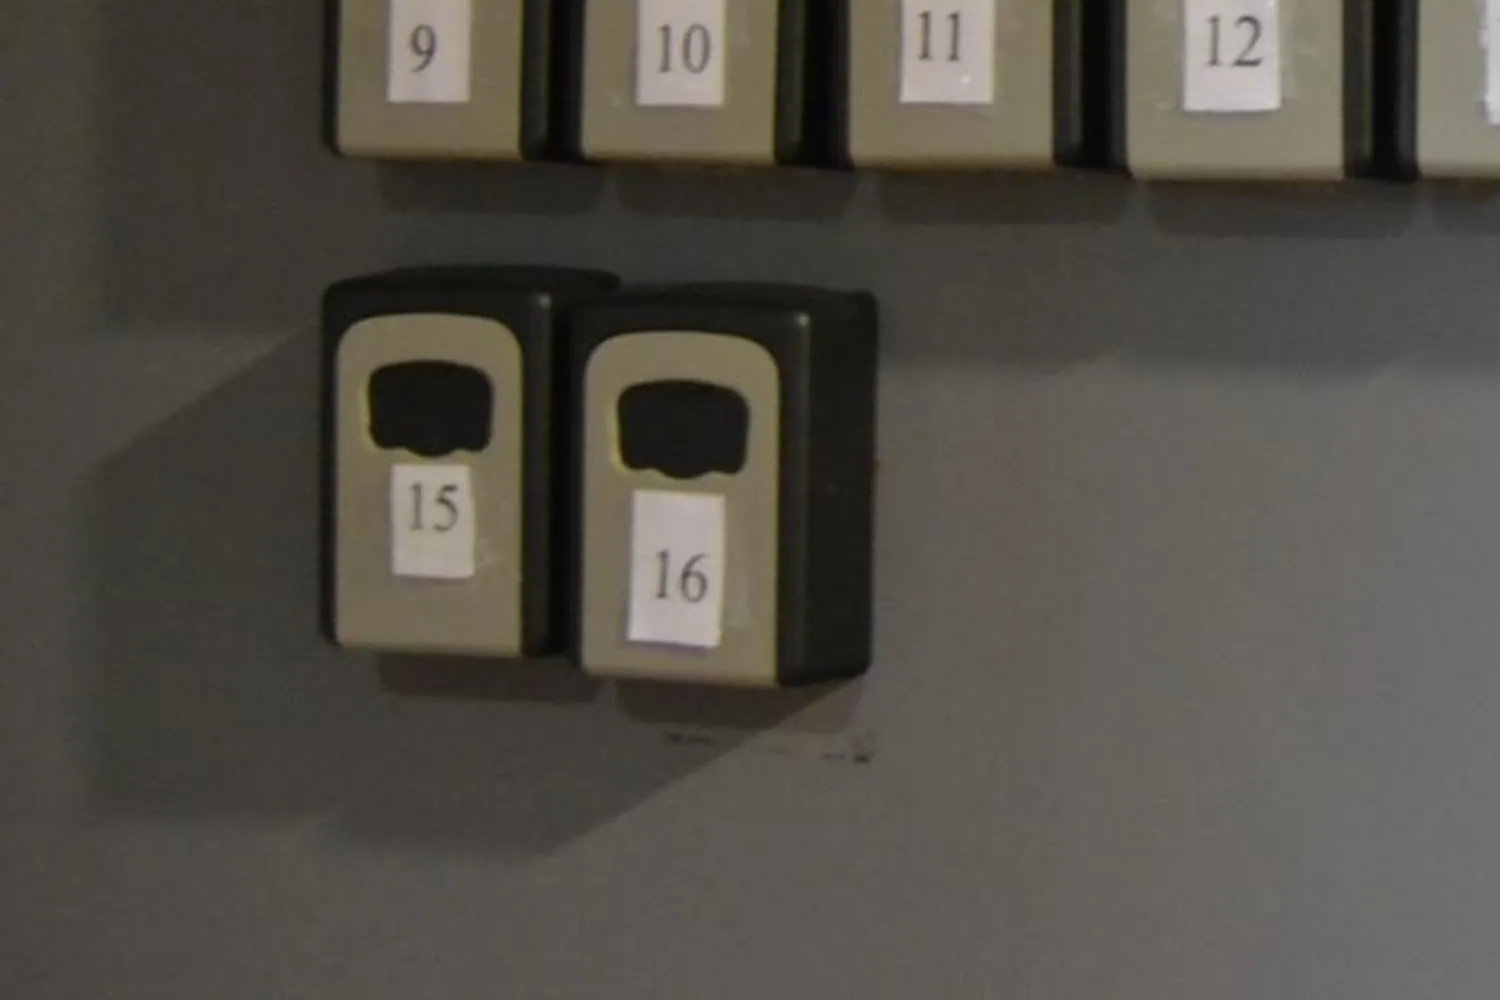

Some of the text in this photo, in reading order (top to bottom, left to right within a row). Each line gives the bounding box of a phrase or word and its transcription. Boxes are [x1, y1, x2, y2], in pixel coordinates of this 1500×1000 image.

[408, 24, 437, 73] 9
[658, 23, 712, 74] 10
[917, 10, 961, 62] 11
[1208, 14, 1262, 68] 12
[410, 482, 459, 533] 15
[655, 549, 709, 603] 16
